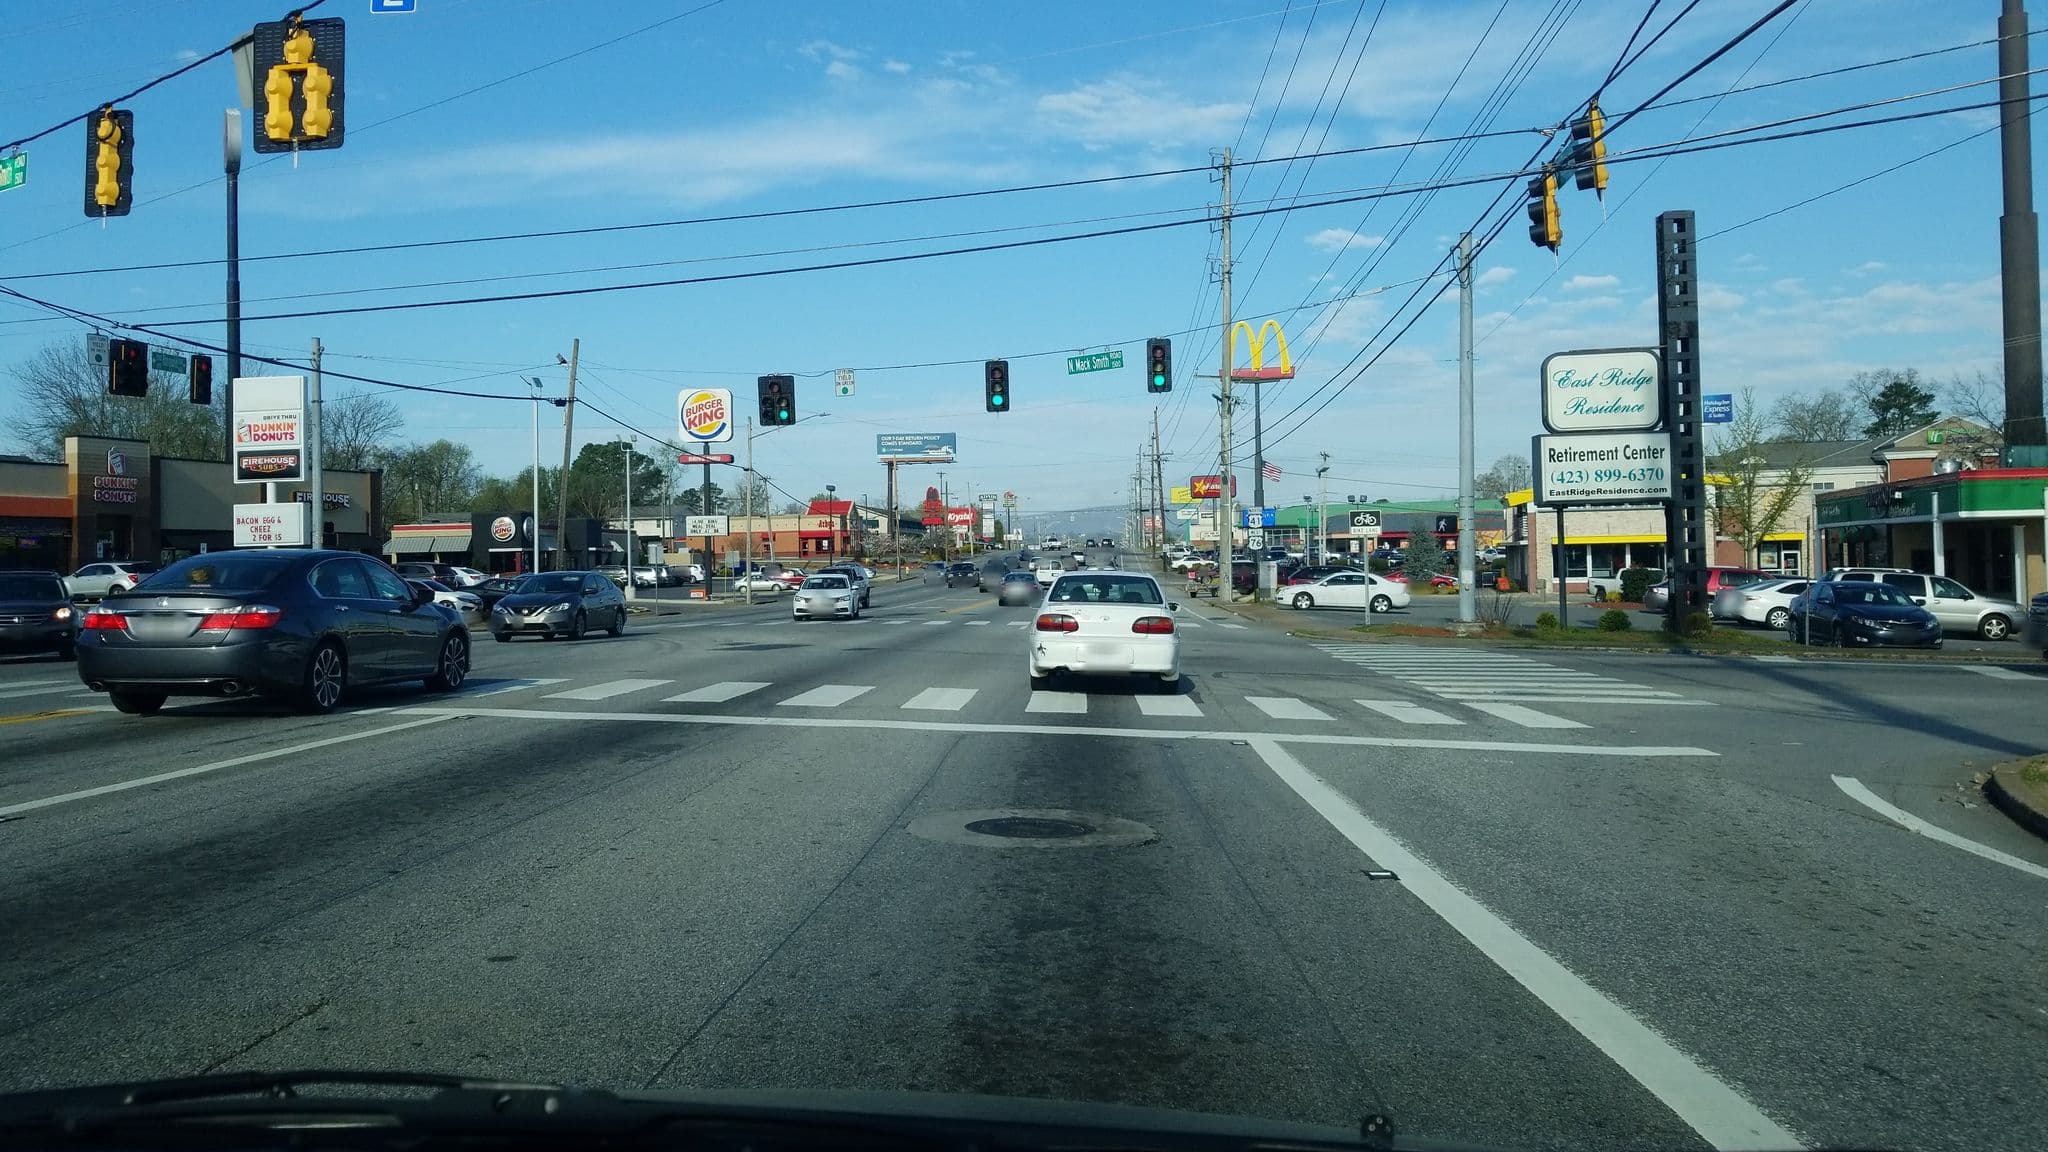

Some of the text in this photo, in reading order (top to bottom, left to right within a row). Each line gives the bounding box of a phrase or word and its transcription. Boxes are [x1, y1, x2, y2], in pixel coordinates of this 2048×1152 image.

[1109, 351, 1121, 359] ROAD
[1075, 358, 1090, 370] Mack
[1092, 355, 1110, 369] Smith
[1553, 367, 1654, 392] East Ridge
[685, 398, 723, 418] BURGER
[1563, 396, 1645, 415] Residence
[1704, 405, 1730, 413] Express
[687, 407, 725, 430] KING
[252, 422, 297, 432] DUNKIN'
[252, 432, 295, 442] DONUTS
[1548, 444, 1665, 463] Retirement Center
[242, 456, 296, 469] FIREHOUSE
[259, 463, 279, 471] SUBS
[1550, 467, 1664, 485] (423) 899-6370
[94, 476, 138, 489] DUNKIN'
[94, 489, 137, 503] DONUTS
[1549, 487, 1668, 497] EastRidgeResidence.com
[296, 491, 350, 508] FIRHOUSE
[236, 517, 259, 525] BACON
[262, 516, 275, 524] EGG
[1250, 517, 1261, 526] 41
[249, 525, 271, 533] CHEEZ
[252, 534, 257, 542] 2
[258, 534, 272, 542] FOR
[1250, 538, 1262, 547] 76
